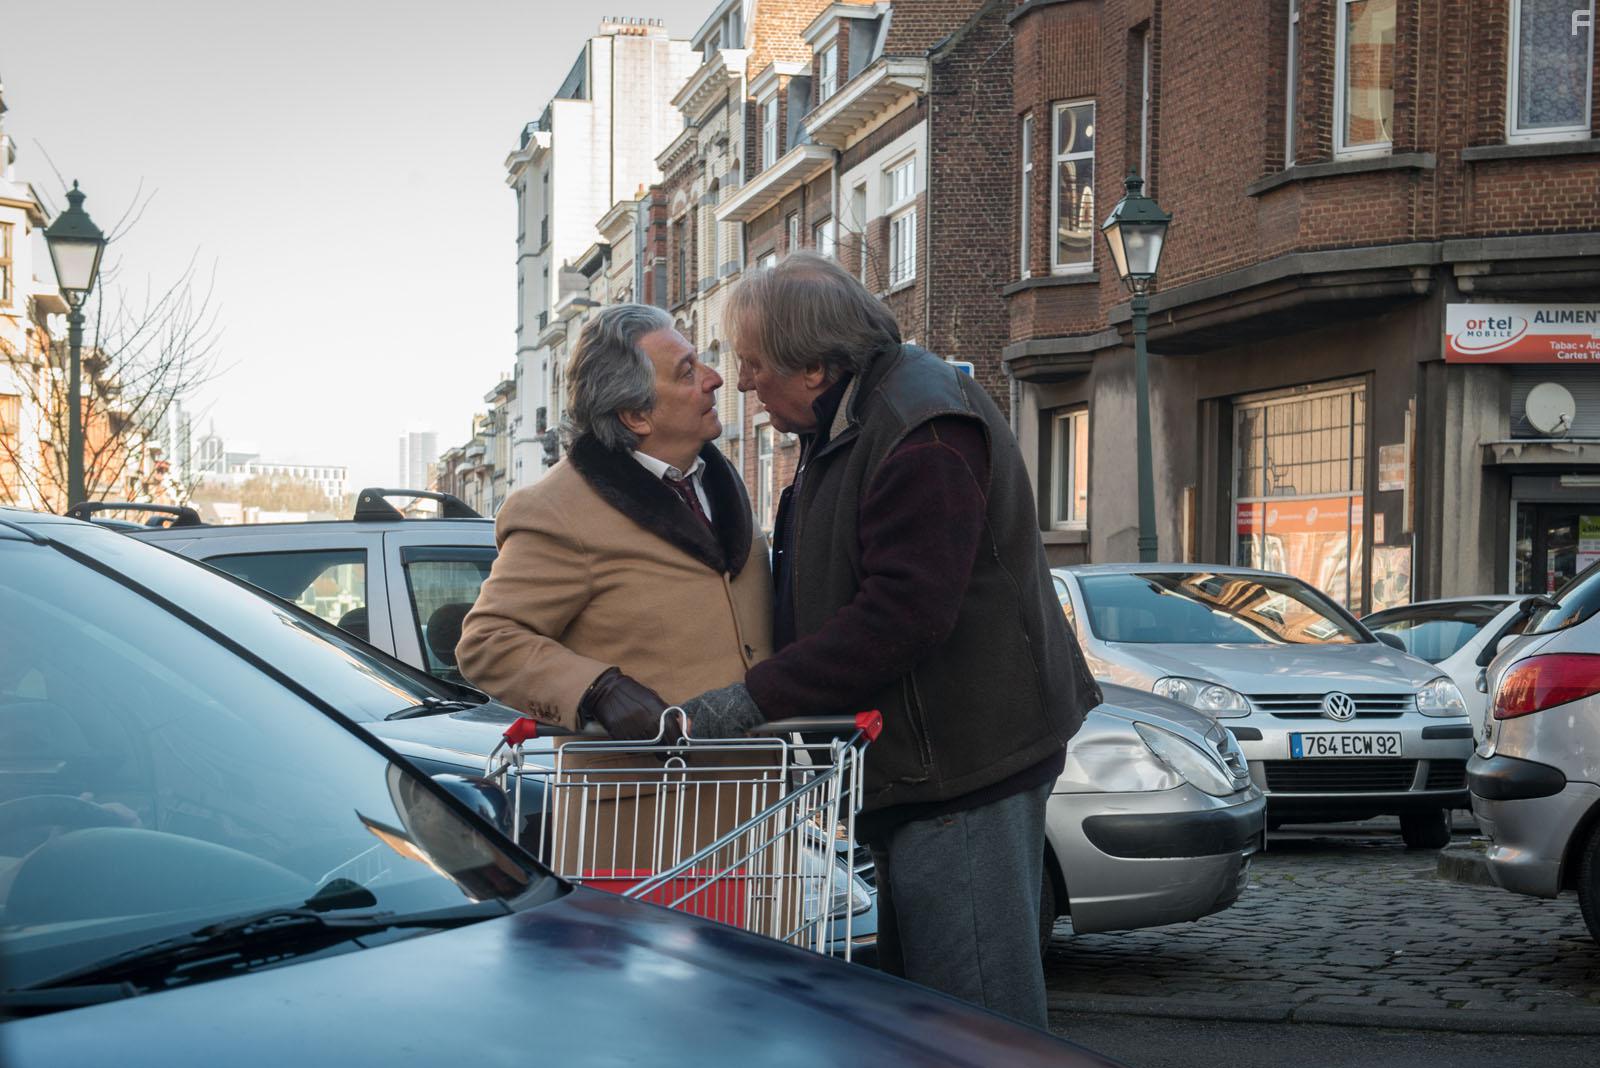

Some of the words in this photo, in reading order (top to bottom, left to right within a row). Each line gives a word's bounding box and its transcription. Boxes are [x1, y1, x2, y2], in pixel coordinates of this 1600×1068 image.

[1466, 316, 1512, 330] ortel
[1534, 310, 1600, 323] ALIMEN
[1550, 341, 1578, 350] Tabac
[1557, 351, 1588, 360] Cartes
[1305, 736, 1338, 754] 764
[1341, 736, 1372, 754] ECW
[1377, 736, 1397, 754] 92
